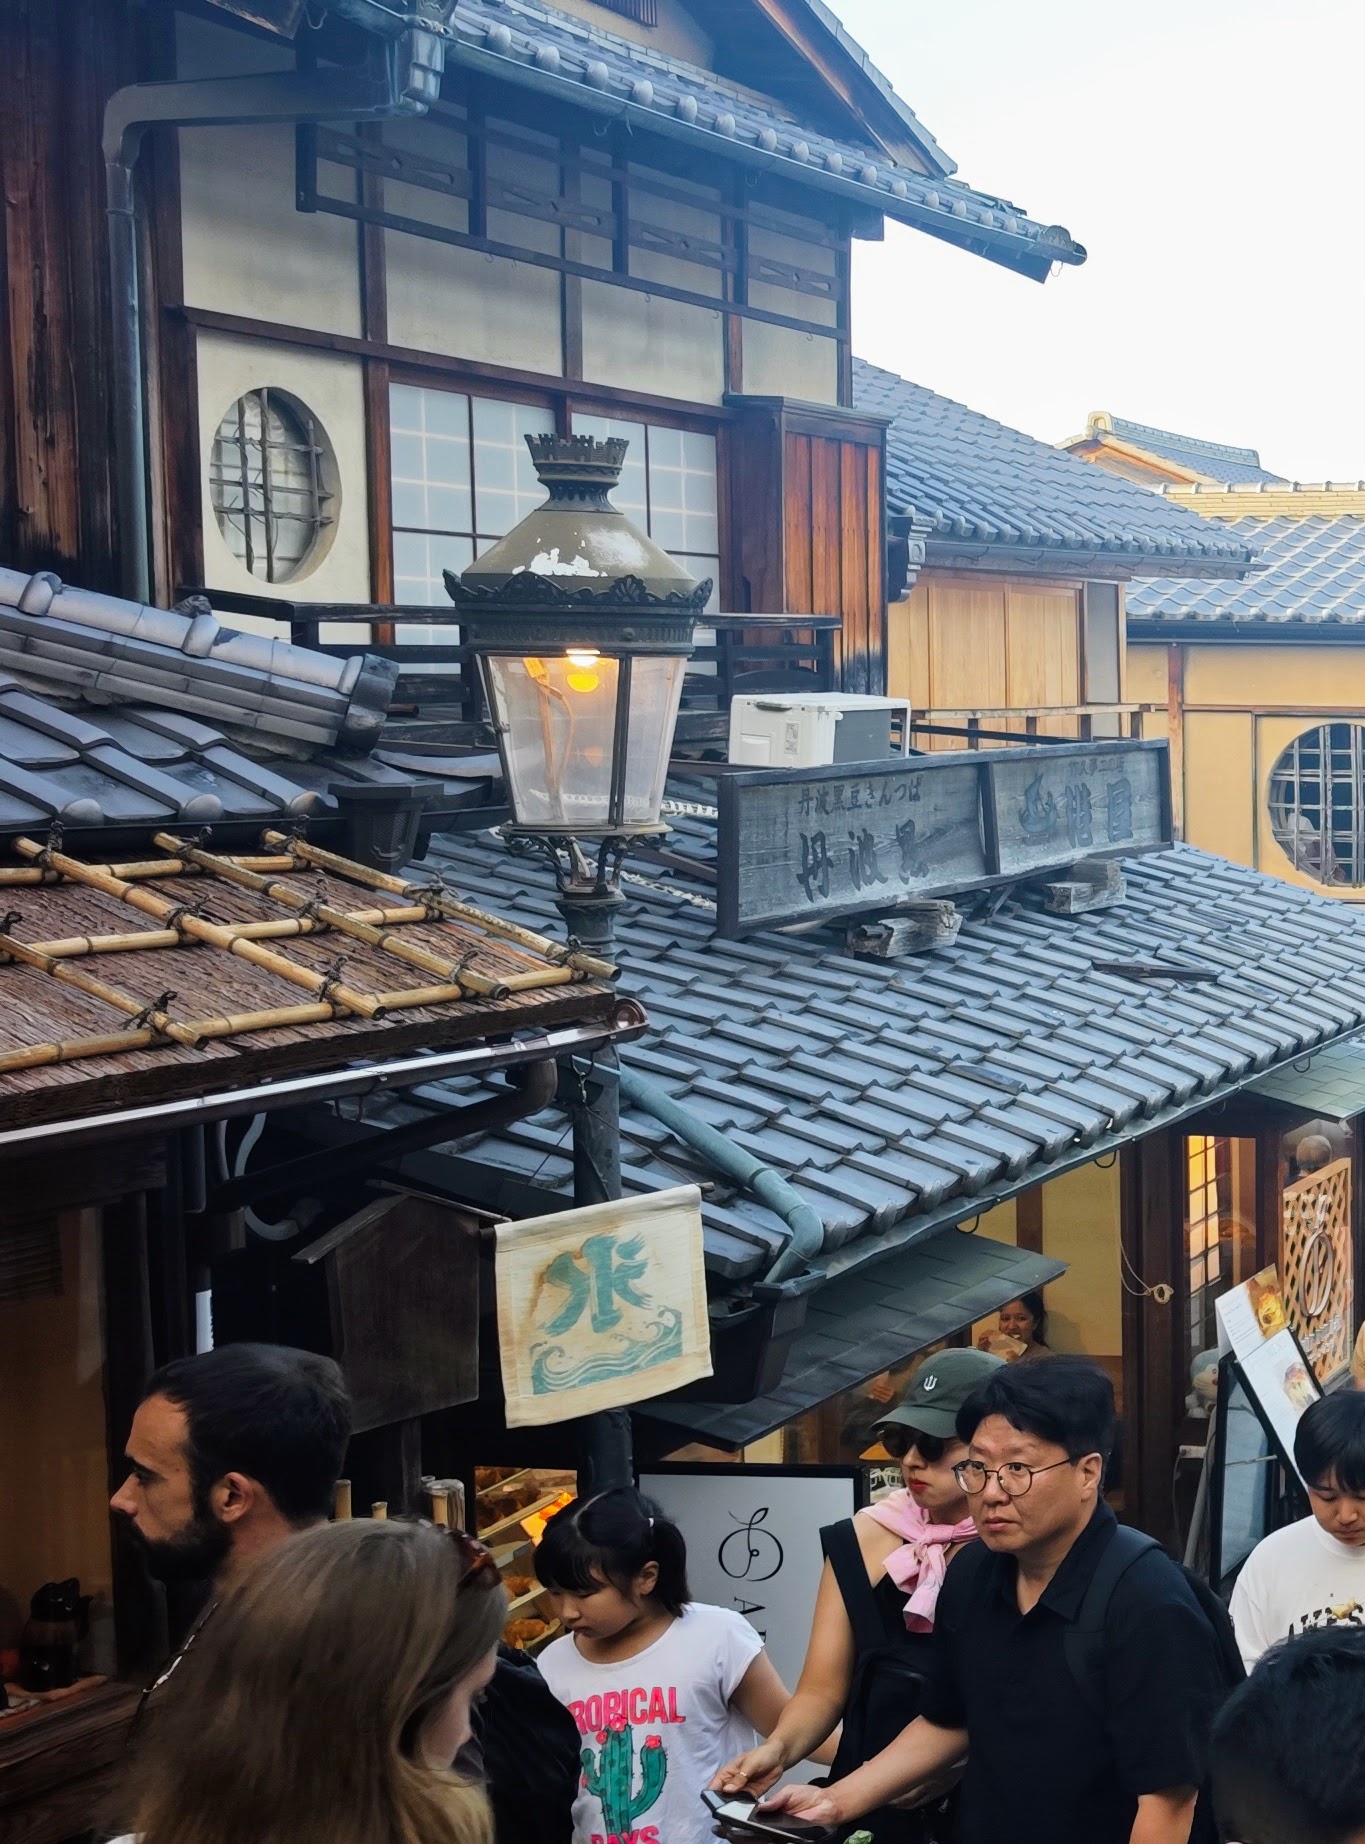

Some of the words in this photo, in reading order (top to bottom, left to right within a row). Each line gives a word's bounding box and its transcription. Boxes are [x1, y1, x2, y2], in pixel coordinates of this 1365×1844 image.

[797, 773, 924, 816] 丹波黒豆きんつば
[566, 1686, 687, 1736] ROPICAL
